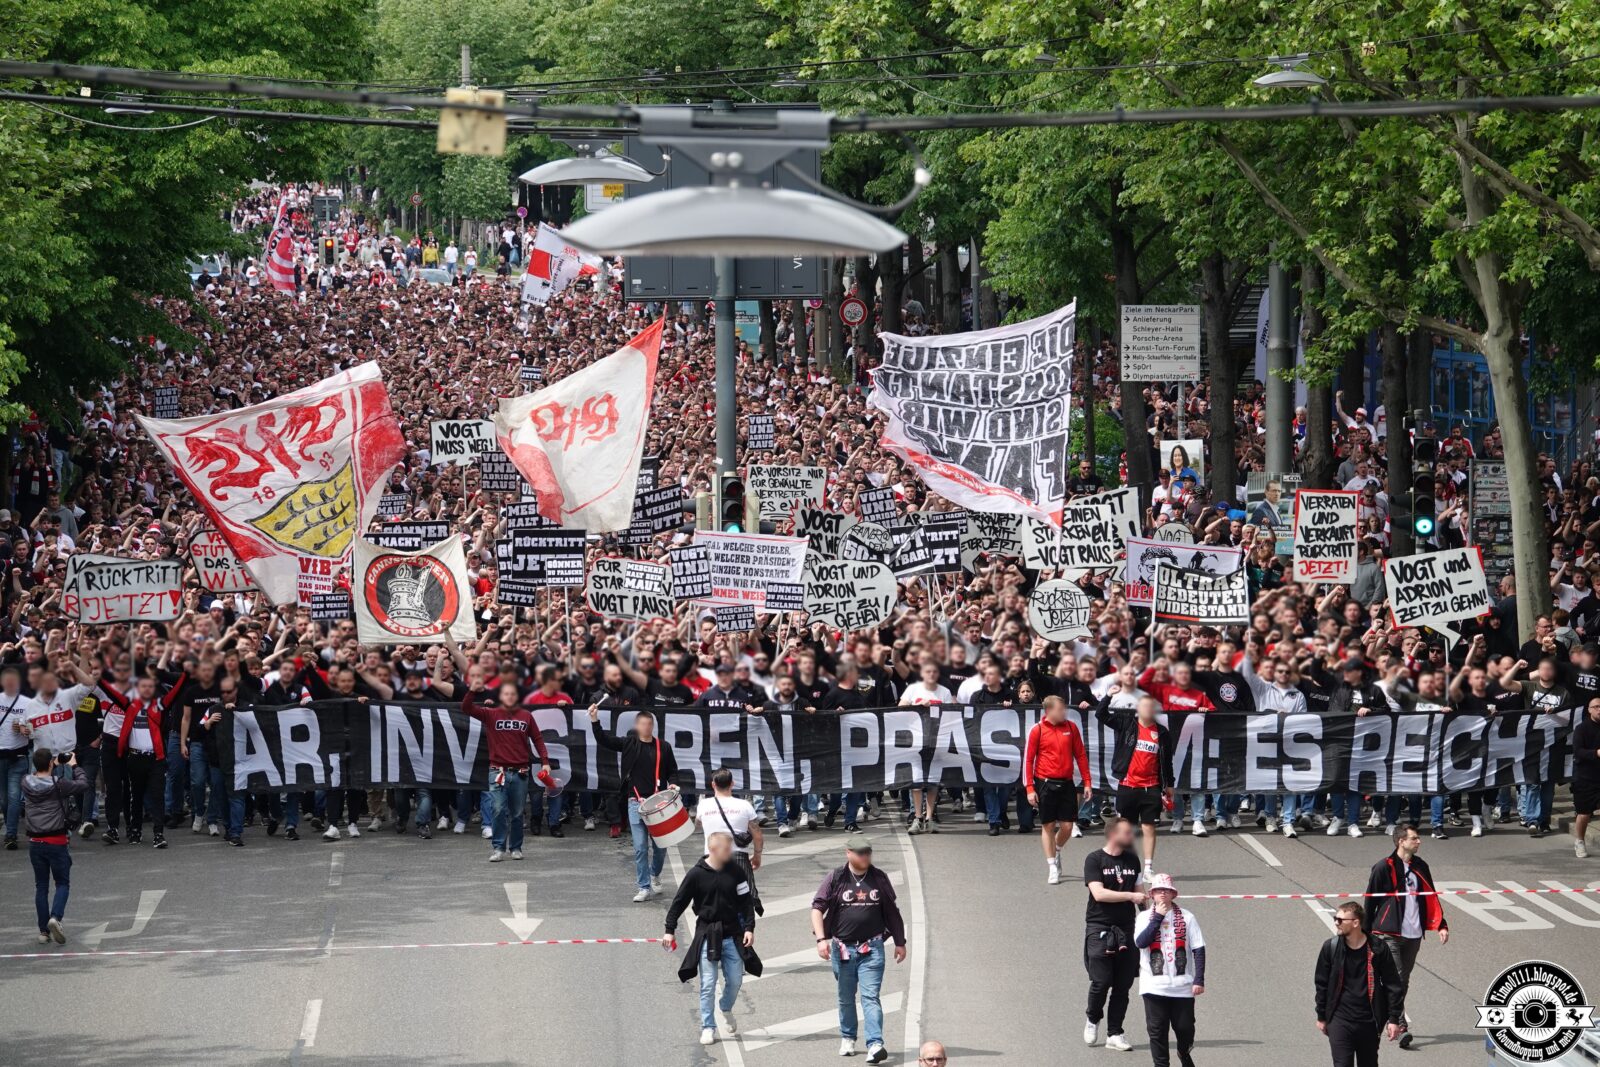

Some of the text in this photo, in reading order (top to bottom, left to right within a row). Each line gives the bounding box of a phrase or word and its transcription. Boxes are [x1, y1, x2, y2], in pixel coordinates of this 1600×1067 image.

[156, 388, 178, 396] VOGT
[156, 396, 178, 405] UND
[156, 410, 178, 418] RAUS
[749, 416, 773, 424] VOGT
[438, 422, 483, 439] VOGT
[749, 424, 774, 434] UND
[435, 440, 465, 456] MUSS
[749, 440, 773, 448] RAUS
[482, 453, 510, 462] VOG
[482, 462, 516, 473] UND
[807, 468, 825, 479] NUR
[252, 451, 335, 505] 18 93
[482, 480, 516, 489] RAUS
[644, 487, 681, 505] MACHT
[860, 490, 893, 502] VOGT
[1300, 495, 1356, 510] VERRATEN
[377, 506, 406, 514] MAUL
[646, 500, 681, 517] VEREIN
[861, 501, 895, 514] UND
[507, 517, 538, 528] HALT
[800, 508, 845, 534] VOGT
[1312, 512, 1340, 525] UND
[1300, 525, 1356, 543] VERKAUFT
[379, 537, 421, 547] MACHT
[514, 536, 585, 547] RÜCKTRITT
[722, 542, 755, 553] WELCHE
[671, 548, 706, 562] VOGT
[1078, 544, 1113, 565] RAUS
[1296, 542, 1356, 559] RÜCKTRITT
[204, 558, 230, 569] DAS
[547, 560, 583, 568] GÖNNER
[714, 553, 751, 564] WELCHER
[298, 556, 331, 575] VfB
[596, 561, 622, 573] FÜR
[672, 560, 709, 576] UND
[711, 564, 790, 578] EINZIGE KONSTANTE
[811, 564, 881, 580] VOGT UND
[1298, 560, 1348, 576] JETZT!
[1390, 552, 1472, 584] VOGT und
[624, 578, 662, 592] MAUL
[673, 574, 710, 585] ADRION
[713, 576, 768, 589] SIND WIR FAN
[1158, 566, 1244, 591] ULTRAS
[500, 583, 537, 592] RÜCKTRITT
[675, 583, 711, 598] RAUS
[713, 588, 739, 598] MMER
[767, 584, 804, 594] GÖNNER
[807, 581, 856, 599] ADRION
[1396, 577, 1454, 606] ADRION
[499, 592, 535, 604] JETZT
[1158, 585, 1245, 605] BEDEUTET
[82, 590, 182, 620] JETZT!
[590, 592, 629, 613] VOGT
[808, 600, 852, 616] ZEIT
[1157, 599, 1248, 617] WIDERSTAND
[312, 610, 348, 618] KAPUTT
[834, 609, 881, 630] GEHEN
[718, 619, 755, 632] MAUL
[495, 719, 528, 732] CC97
[1246, 714, 1324, 792] ES
